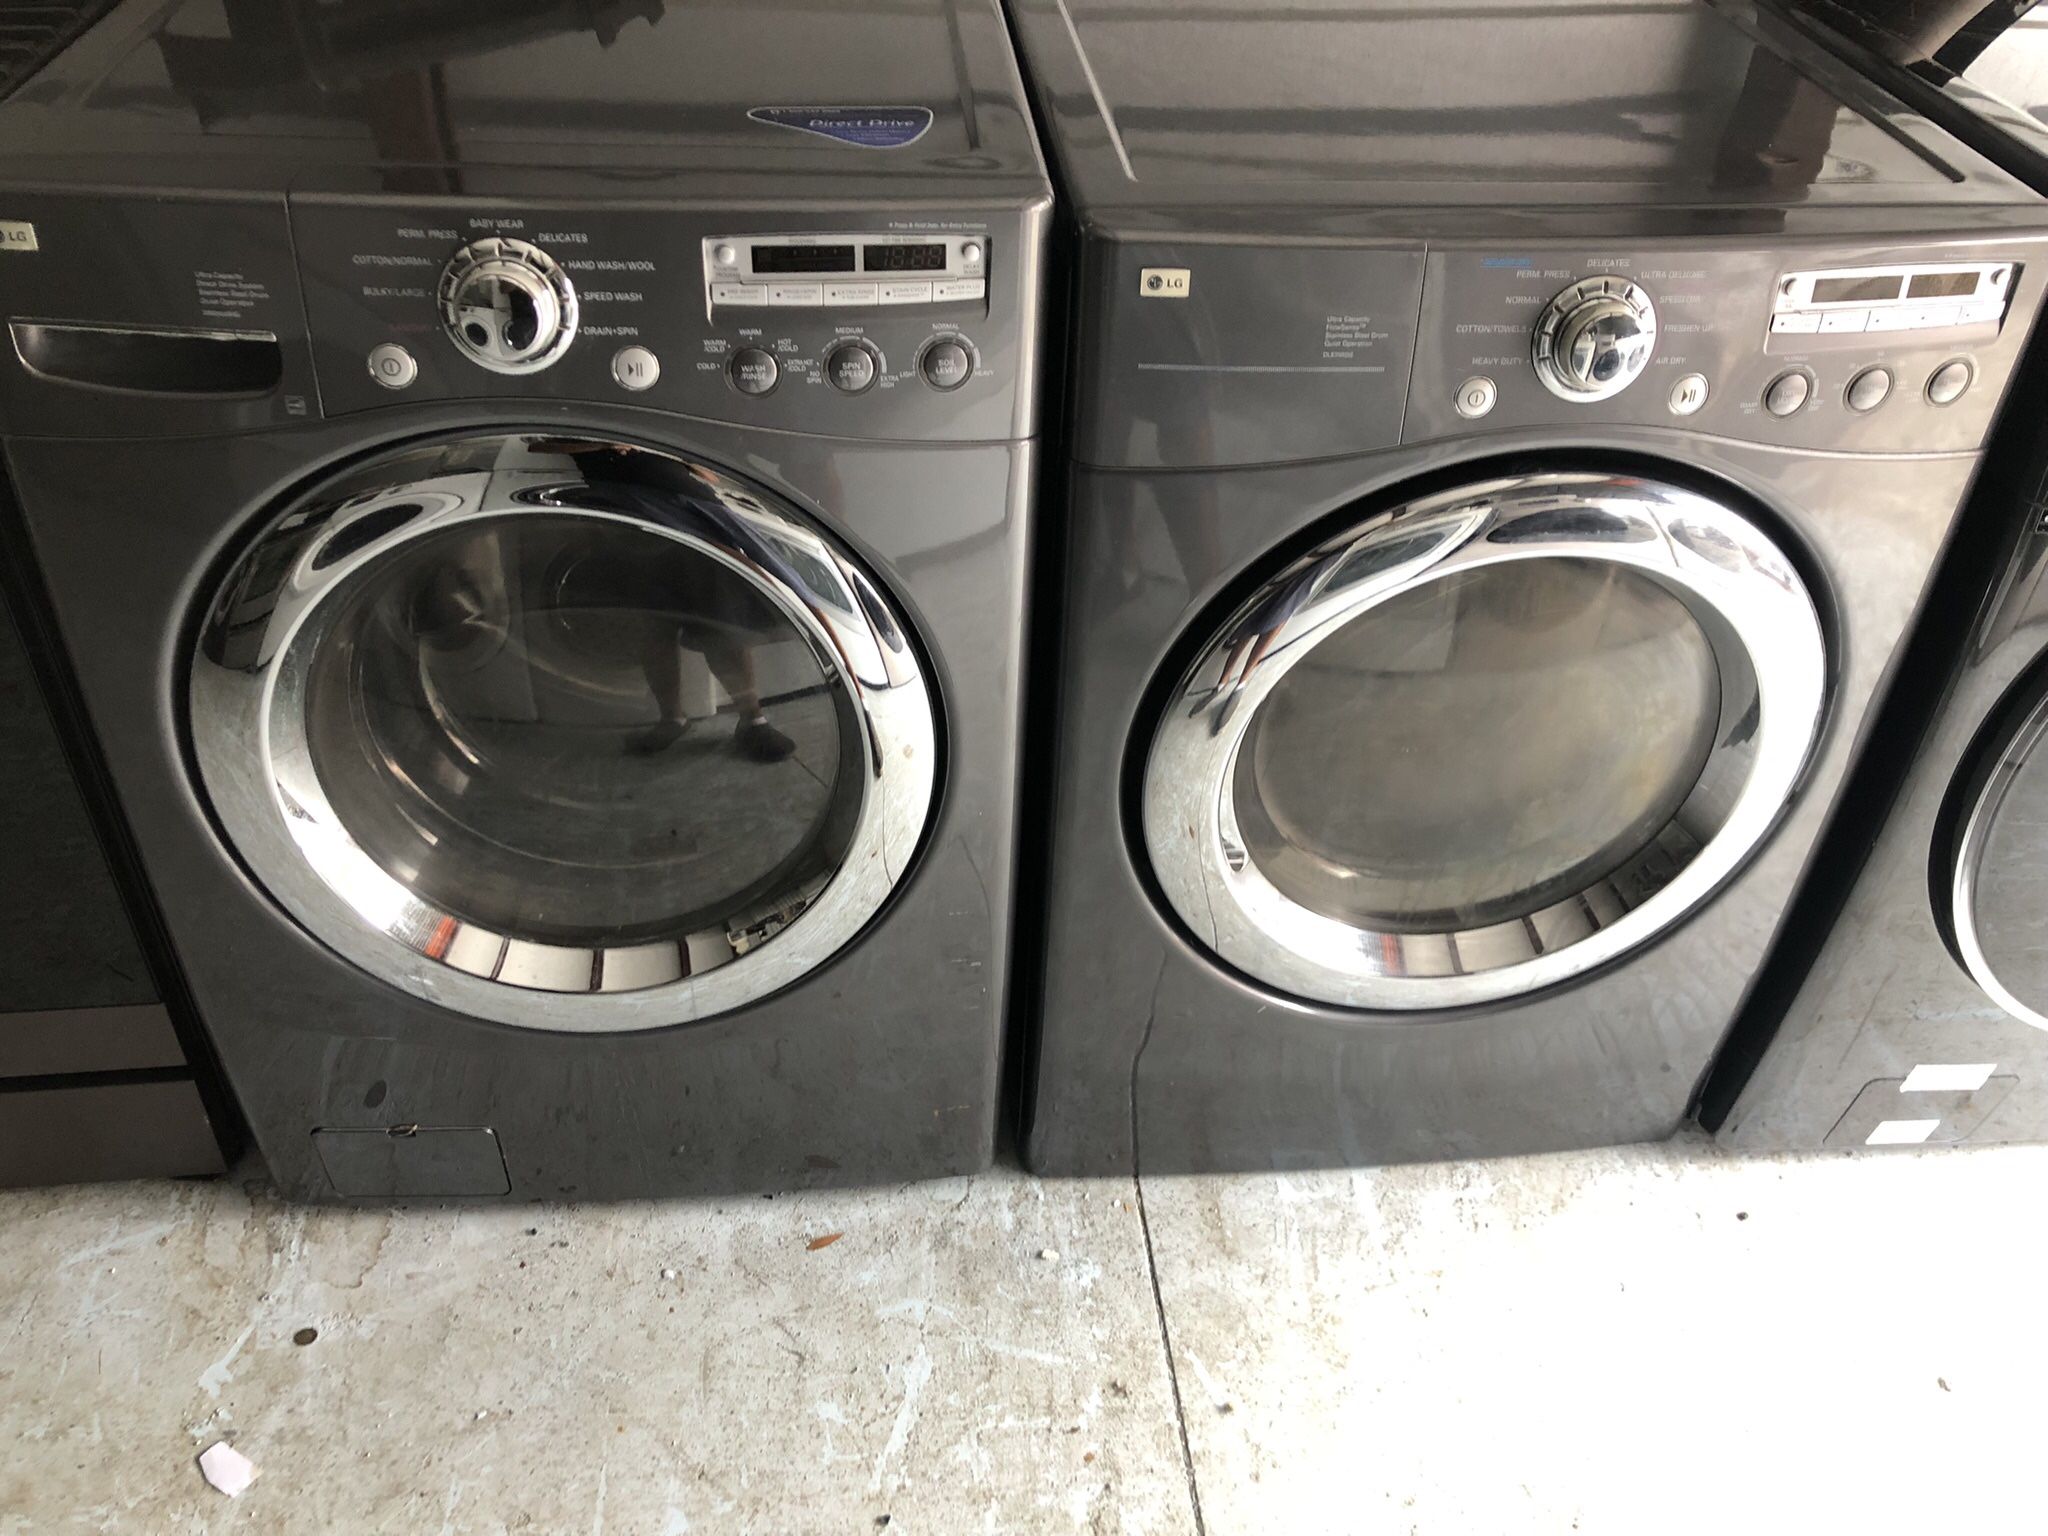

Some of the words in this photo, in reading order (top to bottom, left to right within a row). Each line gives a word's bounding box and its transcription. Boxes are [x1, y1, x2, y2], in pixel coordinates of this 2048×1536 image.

[809, 119, 862, 128] Direct
[869, 119, 915, 128] Drive
[469, 218, 494, 229] BABY
[496, 219, 524, 230] WEAR
[9, 231, 27, 242] LG
[397, 228, 426, 240] PERM.
[428, 229, 458, 240] PRESS
[538, 233, 588, 244] DELICATES
[352, 255, 433, 266] COTTON/NORMAL
[1586, 258, 1631, 268] DELICATES
[568, 260, 594, 271] HAND
[595, 261, 656, 272] WASH/WOOL
[1543, 270, 1571, 279] PRESS
[1641, 271, 1667, 279] ULTRA
[1167, 278, 1183, 289] LG
[363, 287, 426, 298] BULKY/LARGE
[584, 291, 612, 302] SPEED
[613, 292, 643, 302] WASH
[1505, 295, 1541, 305] NORMAL
[584, 326, 638, 336] DRAIN+SPIN
[835, 327, 864, 335] MEDIUM
[932, 322, 960, 331] NORMAL
[1456, 324, 1526, 333] COTTON/TOWELS
[739, 328, 762, 336] WARM
[1471, 356, 1498, 365] HEAVY
[1500, 356, 1523, 366] DUTY
[1656, 356, 1670, 365] AIR
[1670, 356, 1688, 365] DRY
[696, 362, 716, 370] COLD
[741, 364, 766, 372] WASH
[842, 362, 861, 370] SPIN
[935, 366, 958, 375] LEVEL
[839, 370, 865, 378] SPEED
[899, 370, 917, 379] LIGHT
[880, 375, 899, 383] EXTRA
